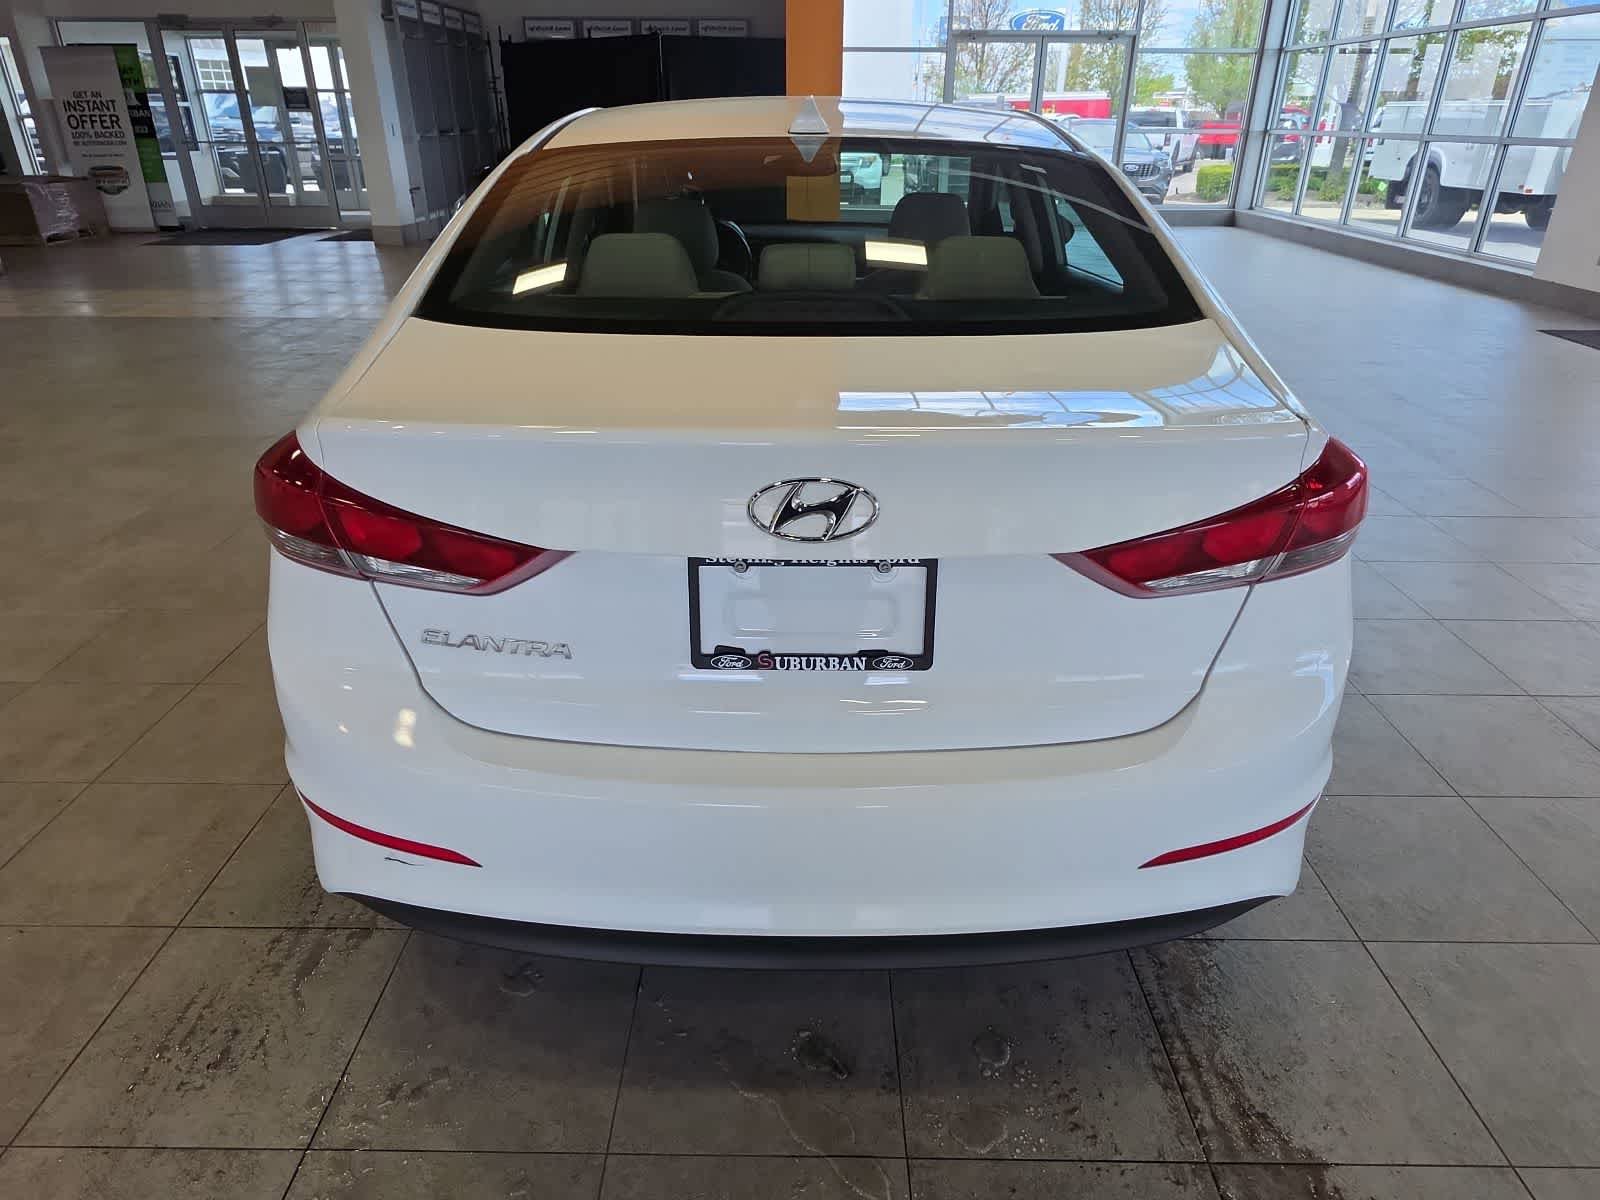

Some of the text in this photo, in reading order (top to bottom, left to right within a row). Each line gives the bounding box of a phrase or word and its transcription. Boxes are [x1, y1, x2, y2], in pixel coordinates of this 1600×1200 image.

[1022, 15, 1060, 31] Ford
[72, 90, 103, 99] GET AN
[63, 99, 116, 112] INSTANT
[67, 114, 122, 130] OFFER
[72, 131, 125, 140] 100% BACKED
[421, 628, 573, 660] ELANTRA
[718, 653, 906, 671] Ford SUBURBAN Ford
